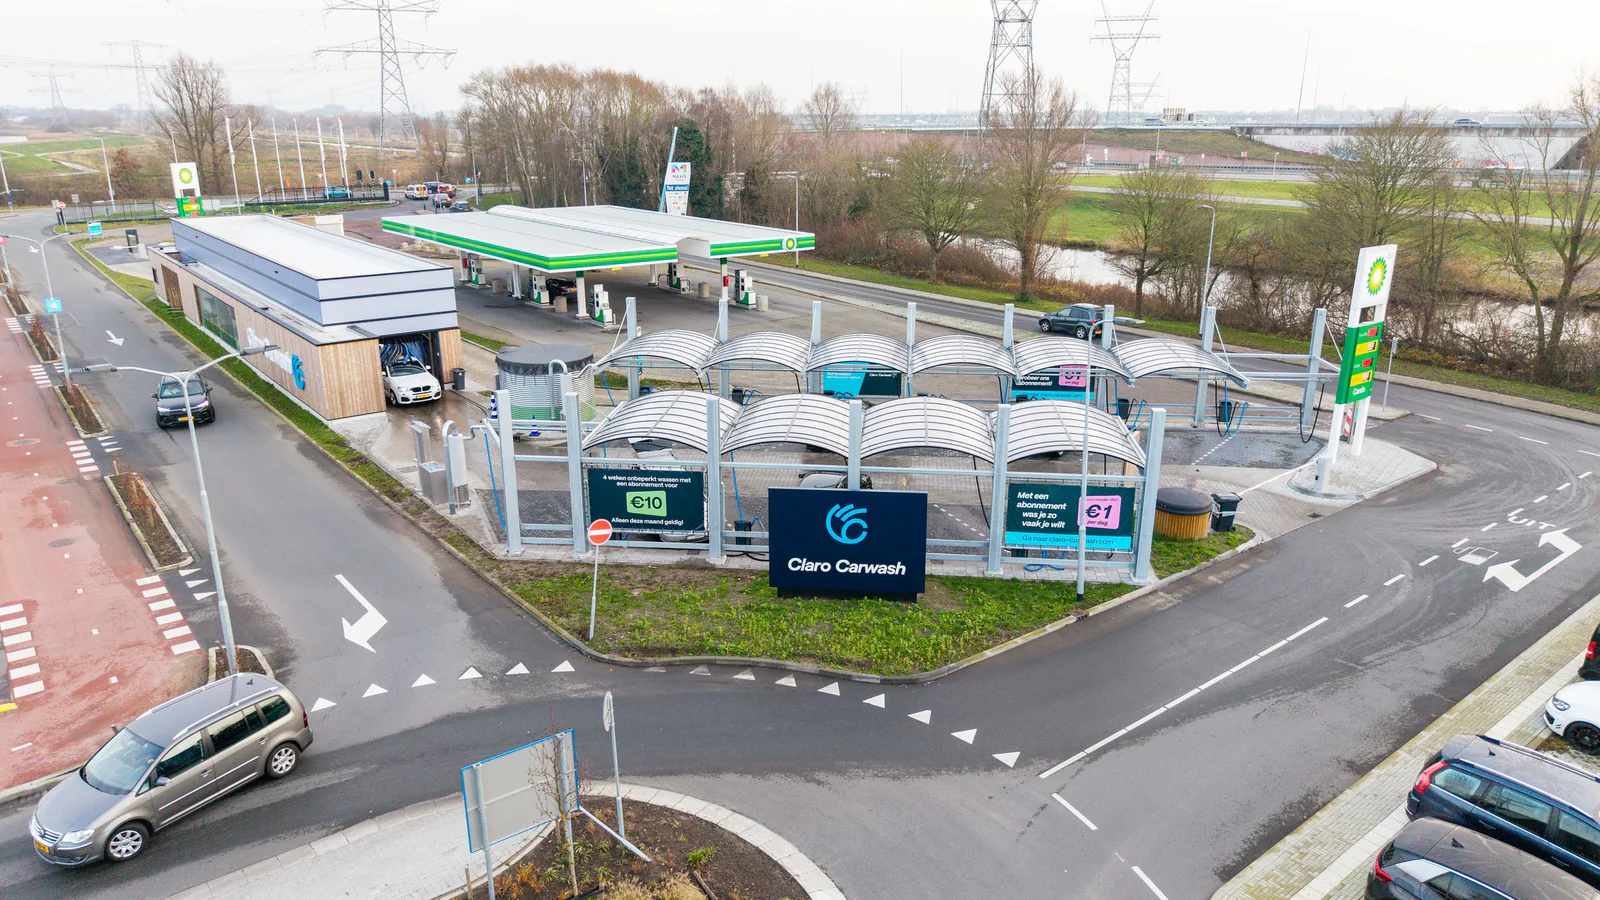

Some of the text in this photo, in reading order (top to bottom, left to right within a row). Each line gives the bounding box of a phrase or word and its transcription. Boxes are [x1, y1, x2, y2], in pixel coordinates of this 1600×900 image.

[630, 496, 662, 509] €10
[1017, 501, 1067, 510] abonnement
[1038, 512, 1046, 520] je
[1085, 504, 1112, 519] €1
[1508, 516, 1556, 529] UIT
[1050, 536, 1114, 544] claro-caash.com
[788, 557, 906, 575] Claro Carwash
